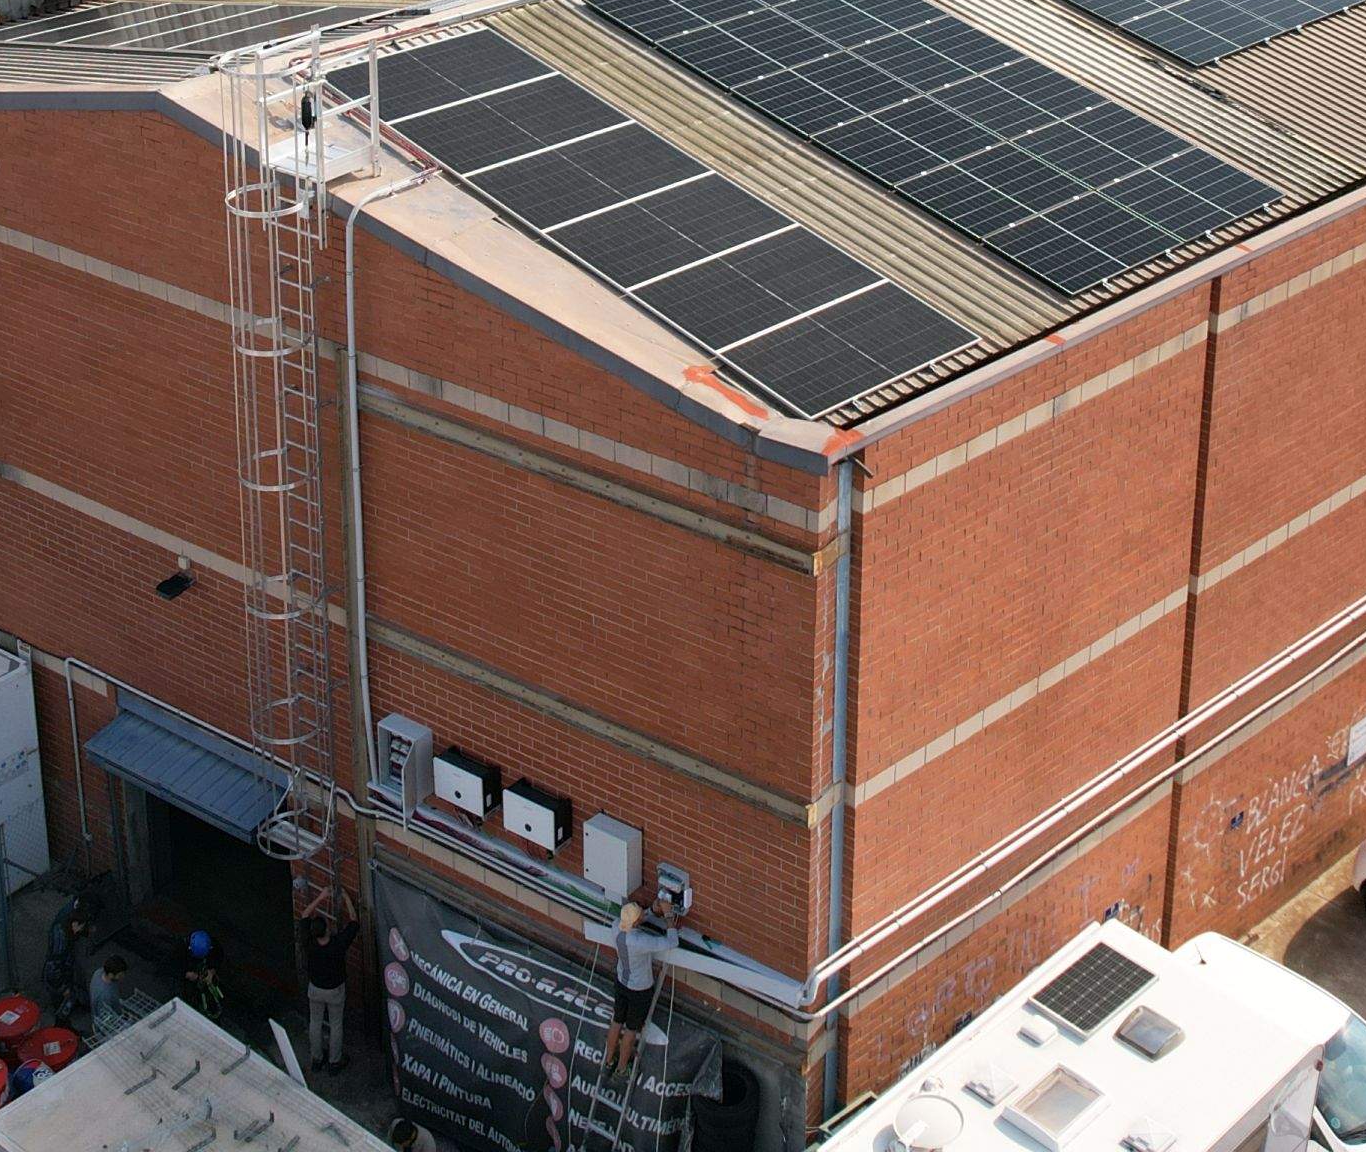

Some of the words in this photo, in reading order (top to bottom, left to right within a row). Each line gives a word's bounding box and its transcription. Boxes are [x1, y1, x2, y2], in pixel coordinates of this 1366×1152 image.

[413, 981, 462, 1024] DIAGNOSI
[462, 1017, 477, 1034] DE
[478, 1022, 528, 1064] VEHICLES
[462, 984, 481, 1005] EN
[479, 992, 529, 1032] GENERAL
[401, 1052, 433, 1083] XAPA
[438, 1074, 493, 1110] PINTURA
[475, 1063, 535, 1102] ALINEACIÓ
[468, 1118, 486, 1137] DEL
